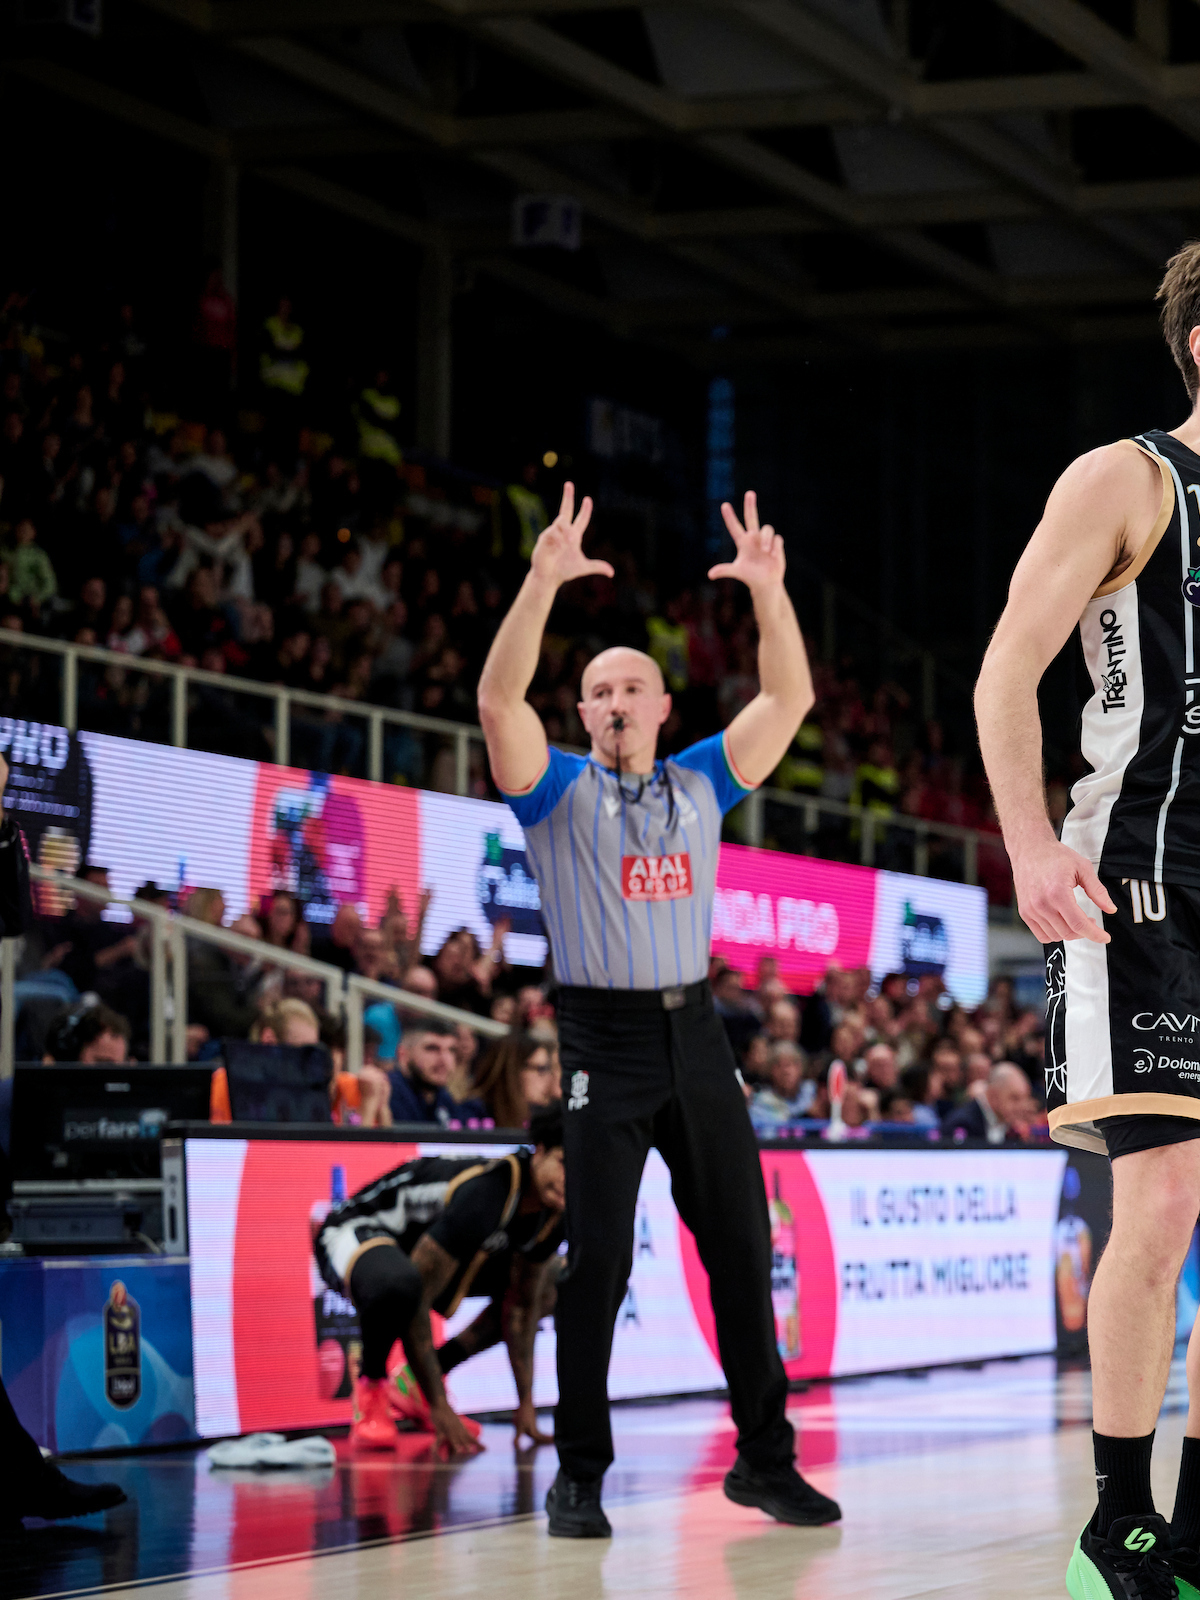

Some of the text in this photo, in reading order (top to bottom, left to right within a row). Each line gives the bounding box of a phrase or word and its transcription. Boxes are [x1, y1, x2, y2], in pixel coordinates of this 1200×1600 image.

[1100, 609, 1127, 714] TRENTINO
[628, 874, 687, 894] GROUP
[1122, 877, 1167, 924] 10
[1158, 1035, 1194, 1044] TRENTO
[850, 1184, 1018, 1227] IL GUSTO DELLA
[842, 1258, 923, 1303] FRUTTA
[933, 1252, 1030, 1297] MIGLIORE
